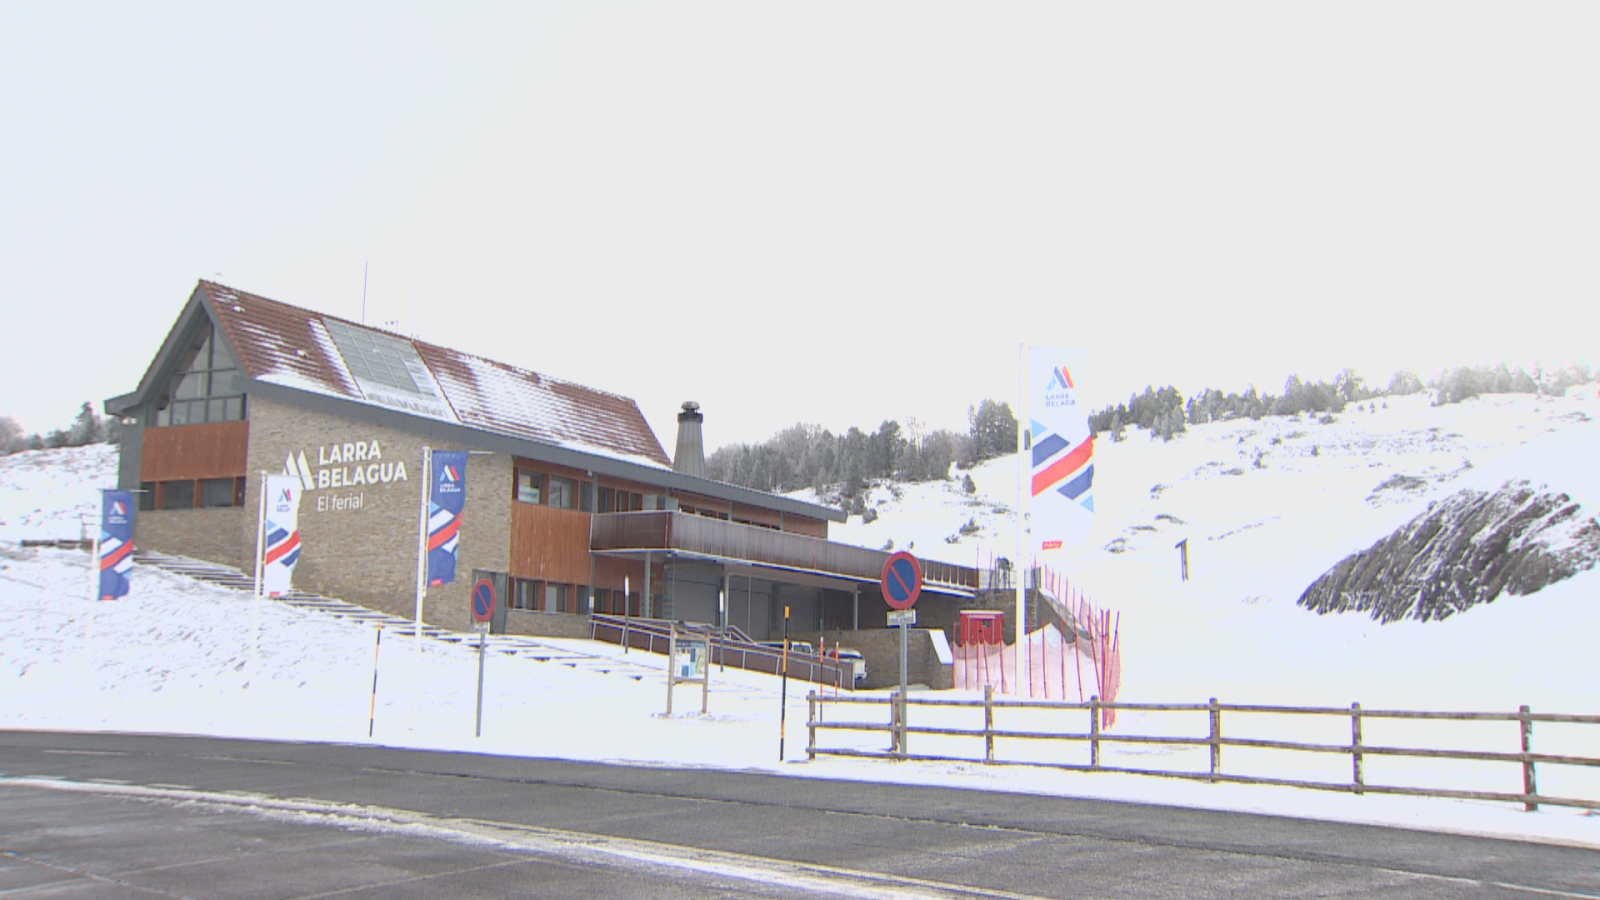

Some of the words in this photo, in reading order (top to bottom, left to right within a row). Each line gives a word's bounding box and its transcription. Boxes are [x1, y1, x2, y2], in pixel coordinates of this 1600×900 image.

[318, 439, 382, 466] LARRA
[318, 460, 408, 489] BELAGUA
[317, 496, 329, 512] El
[332, 491, 364, 511] ferial
